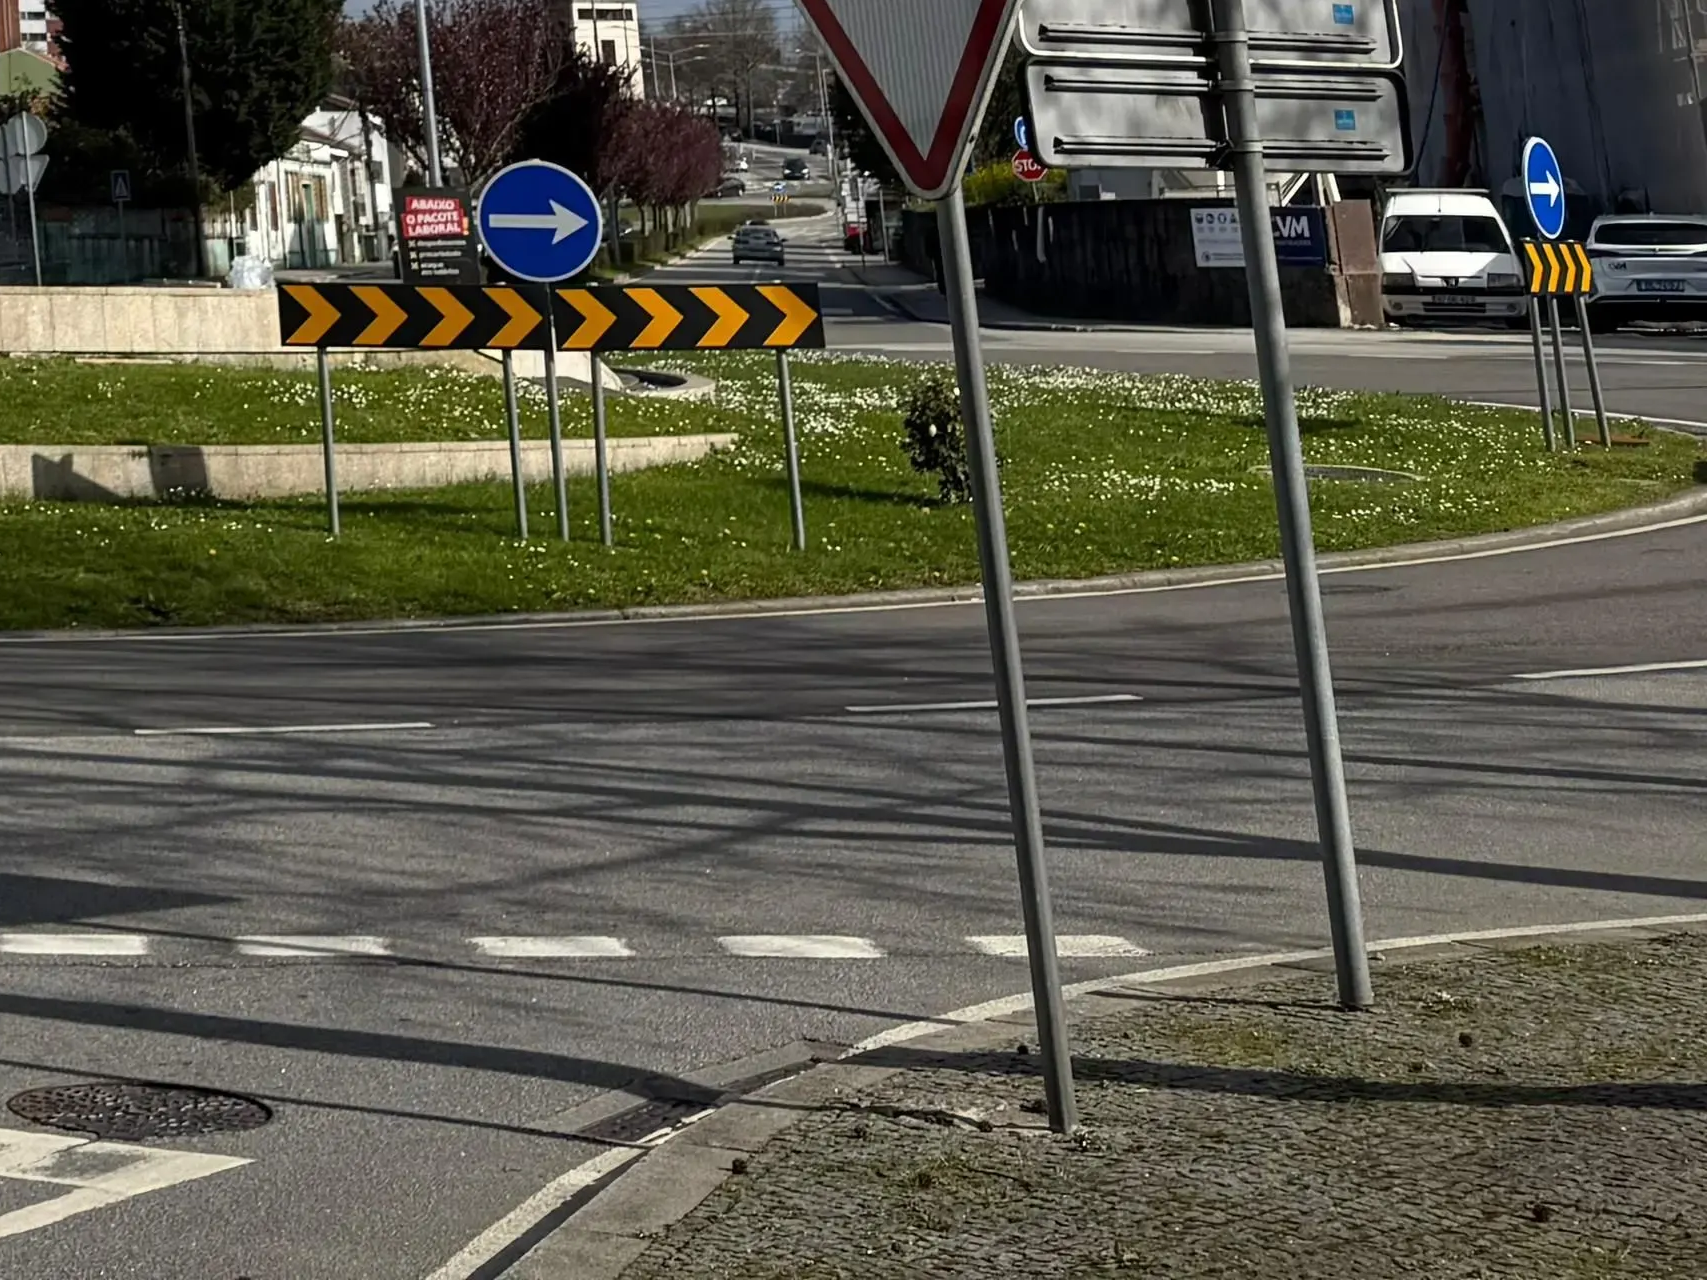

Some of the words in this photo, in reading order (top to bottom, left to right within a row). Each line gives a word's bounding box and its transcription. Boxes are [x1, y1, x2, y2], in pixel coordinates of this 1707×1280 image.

[1015, 159, 1041, 172] STO
[411, 199, 455, 210] ABAIXO
[406, 214, 416, 224] O
[417, 211, 460, 224] PACOTE
